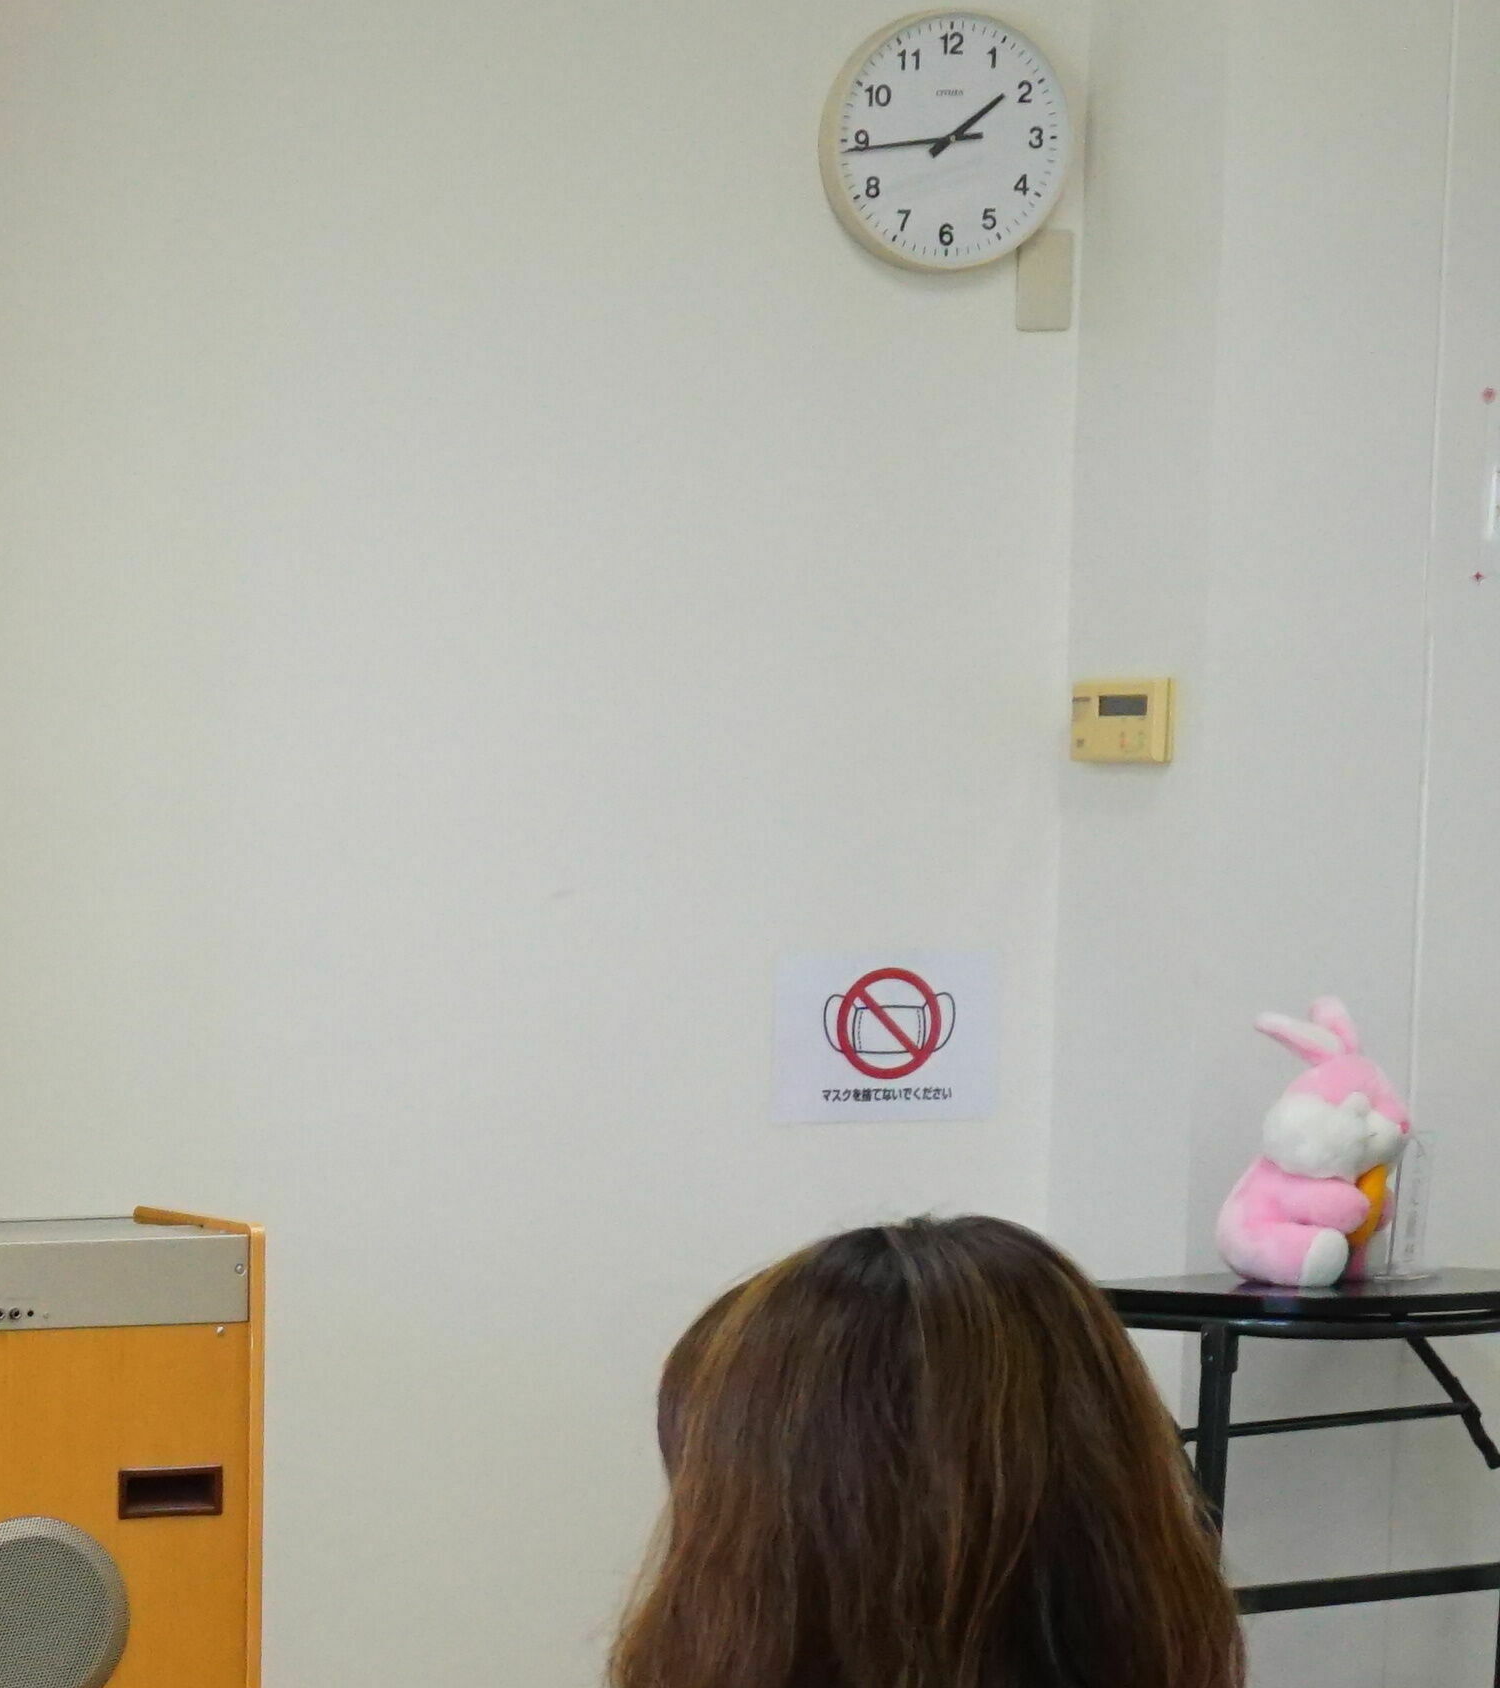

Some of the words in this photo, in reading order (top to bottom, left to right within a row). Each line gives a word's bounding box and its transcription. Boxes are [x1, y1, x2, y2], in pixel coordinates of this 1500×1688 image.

[940, 32, 964, 56] 12
[896, 49, 921, 72] 11
[986, 48, 997, 69] 1
[865, 84, 892, 108] 10
[1017, 80, 1033, 104] 2
[854, 130, 870, 150] 9
[1028, 126, 1044, 149] 3
[865, 176, 880, 199] 8
[1014, 175, 1029, 197] 4
[897, 209, 911, 232] 7
[981, 208, 997, 231] 5
[938, 223, 954, 246] 6
[821, 1087, 953, 1102] マスクを捨てないでください
